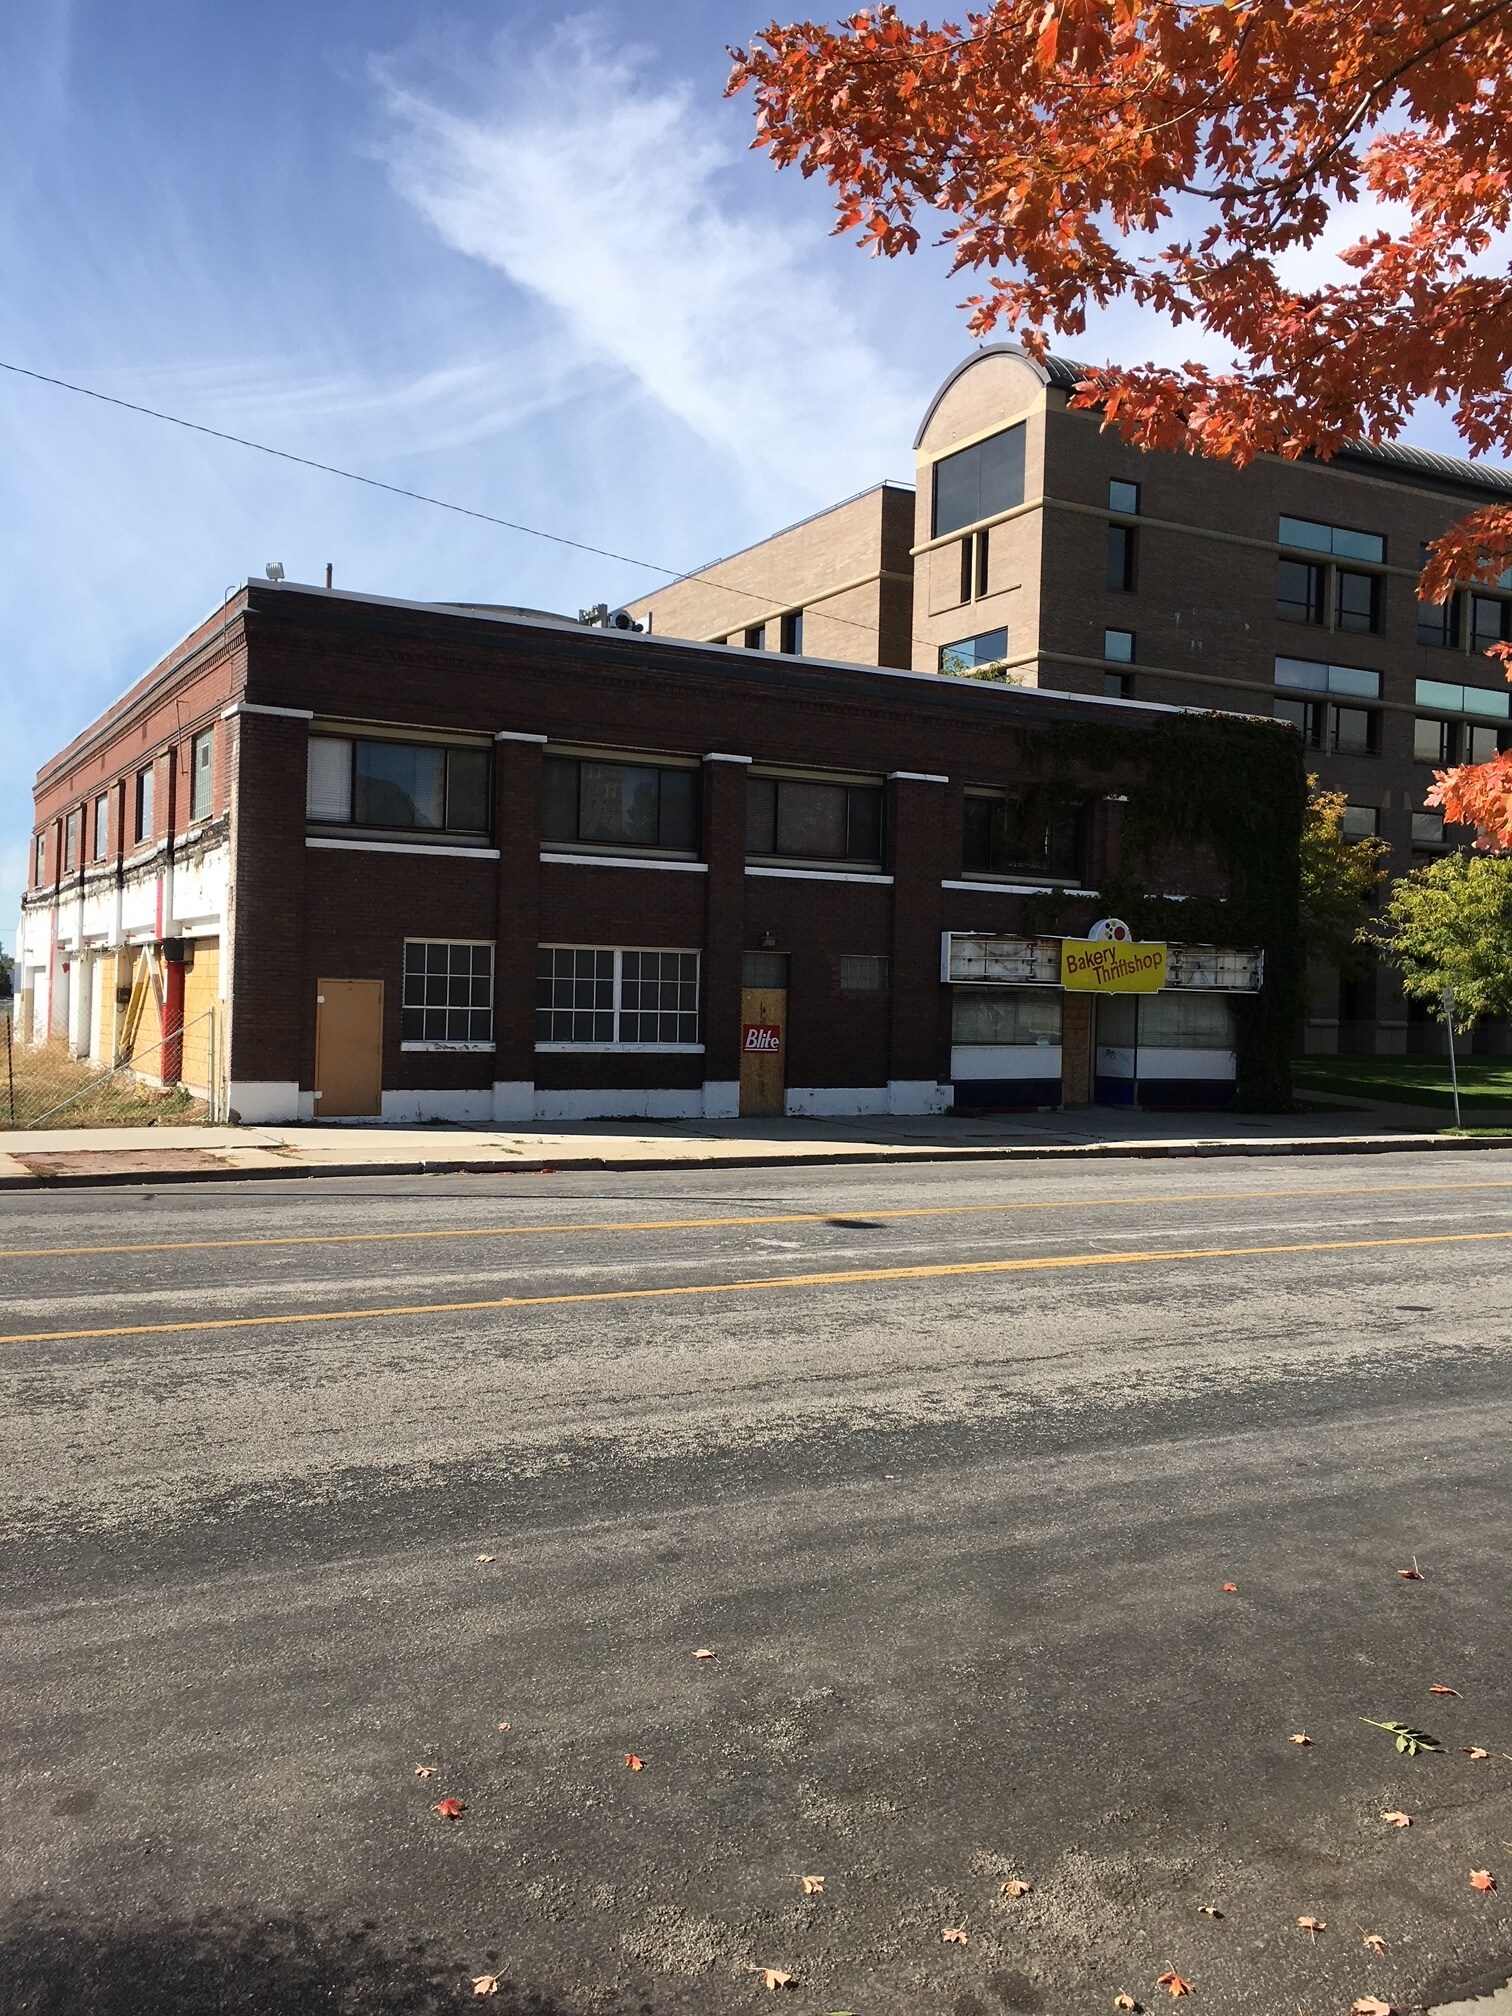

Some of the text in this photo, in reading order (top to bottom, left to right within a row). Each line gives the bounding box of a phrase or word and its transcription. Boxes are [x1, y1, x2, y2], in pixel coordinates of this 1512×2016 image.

[1066, 946, 1116, 974] Bakery
[1092, 951, 1163, 985] Thriftshop
[745, 1028, 780, 1049] Blite
